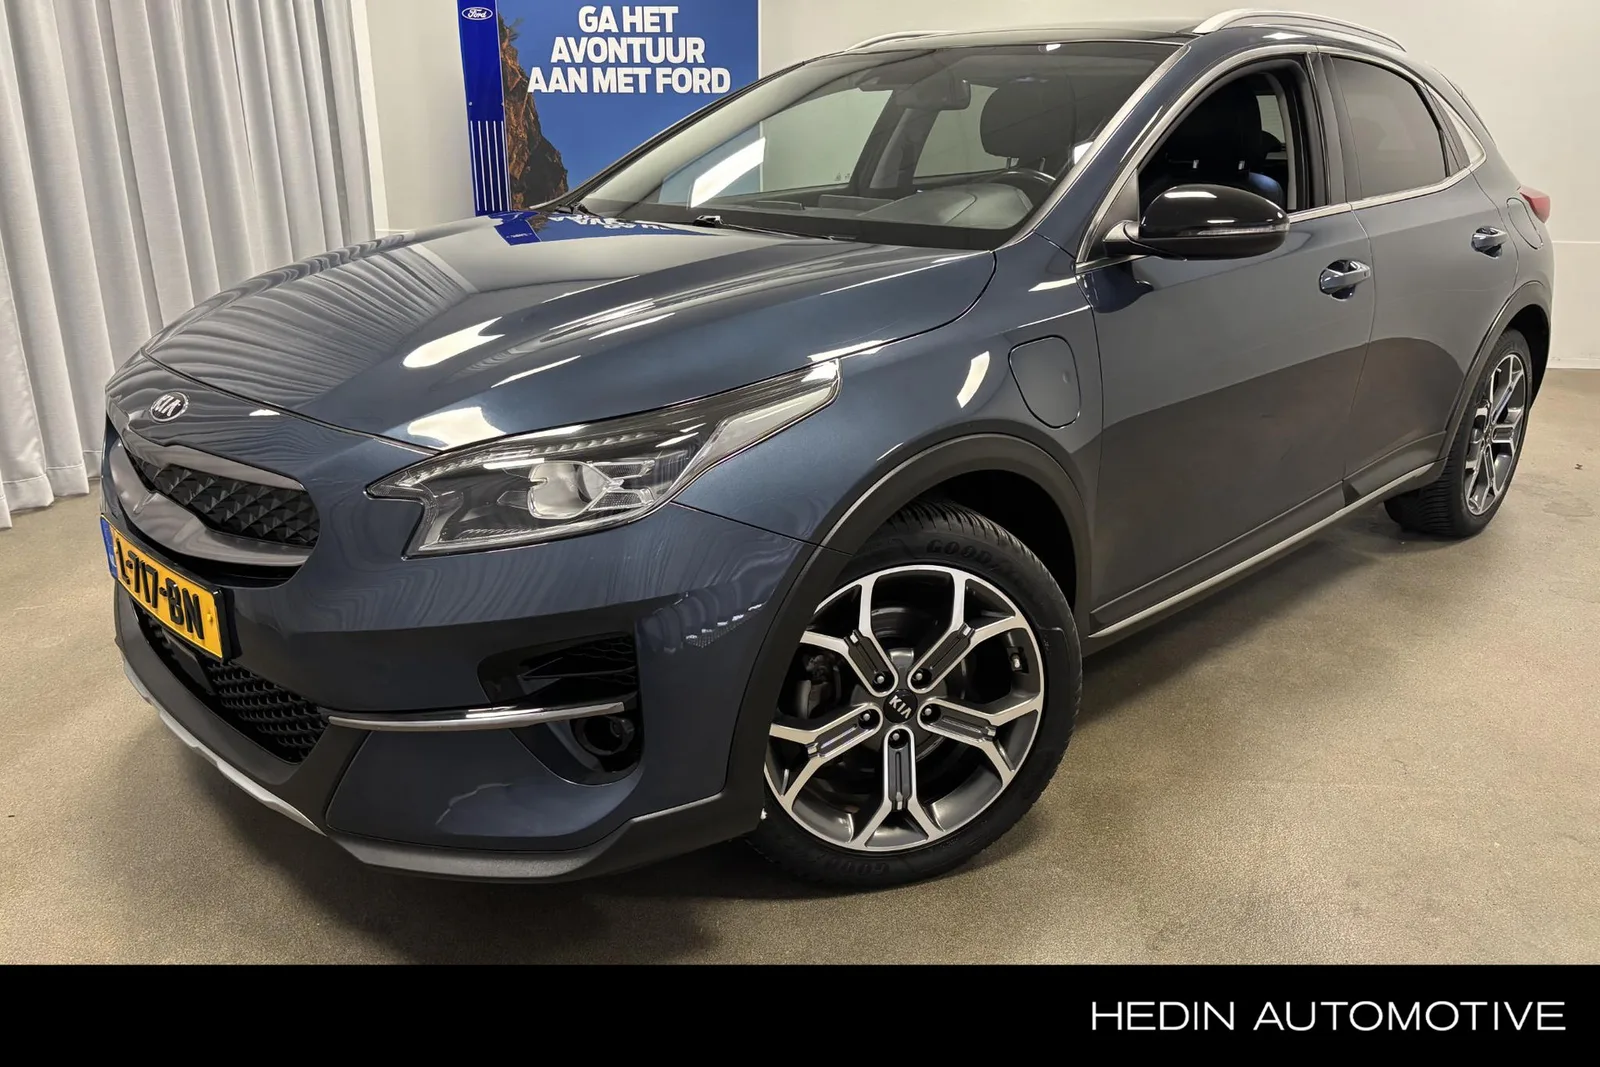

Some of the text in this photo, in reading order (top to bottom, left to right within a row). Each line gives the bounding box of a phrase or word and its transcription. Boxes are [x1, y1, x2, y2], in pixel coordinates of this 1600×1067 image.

[467, 8, 487, 18] Ford
[578, 6, 679, 33] GA HET
[550, 37, 705, 64] AVONTUUR
[527, 67, 731, 94] AAN MET FORD
[153, 394, 181, 417] KIA
[115, 537, 205, 640] L-717-BN
[888, 694, 912, 719] KIA
